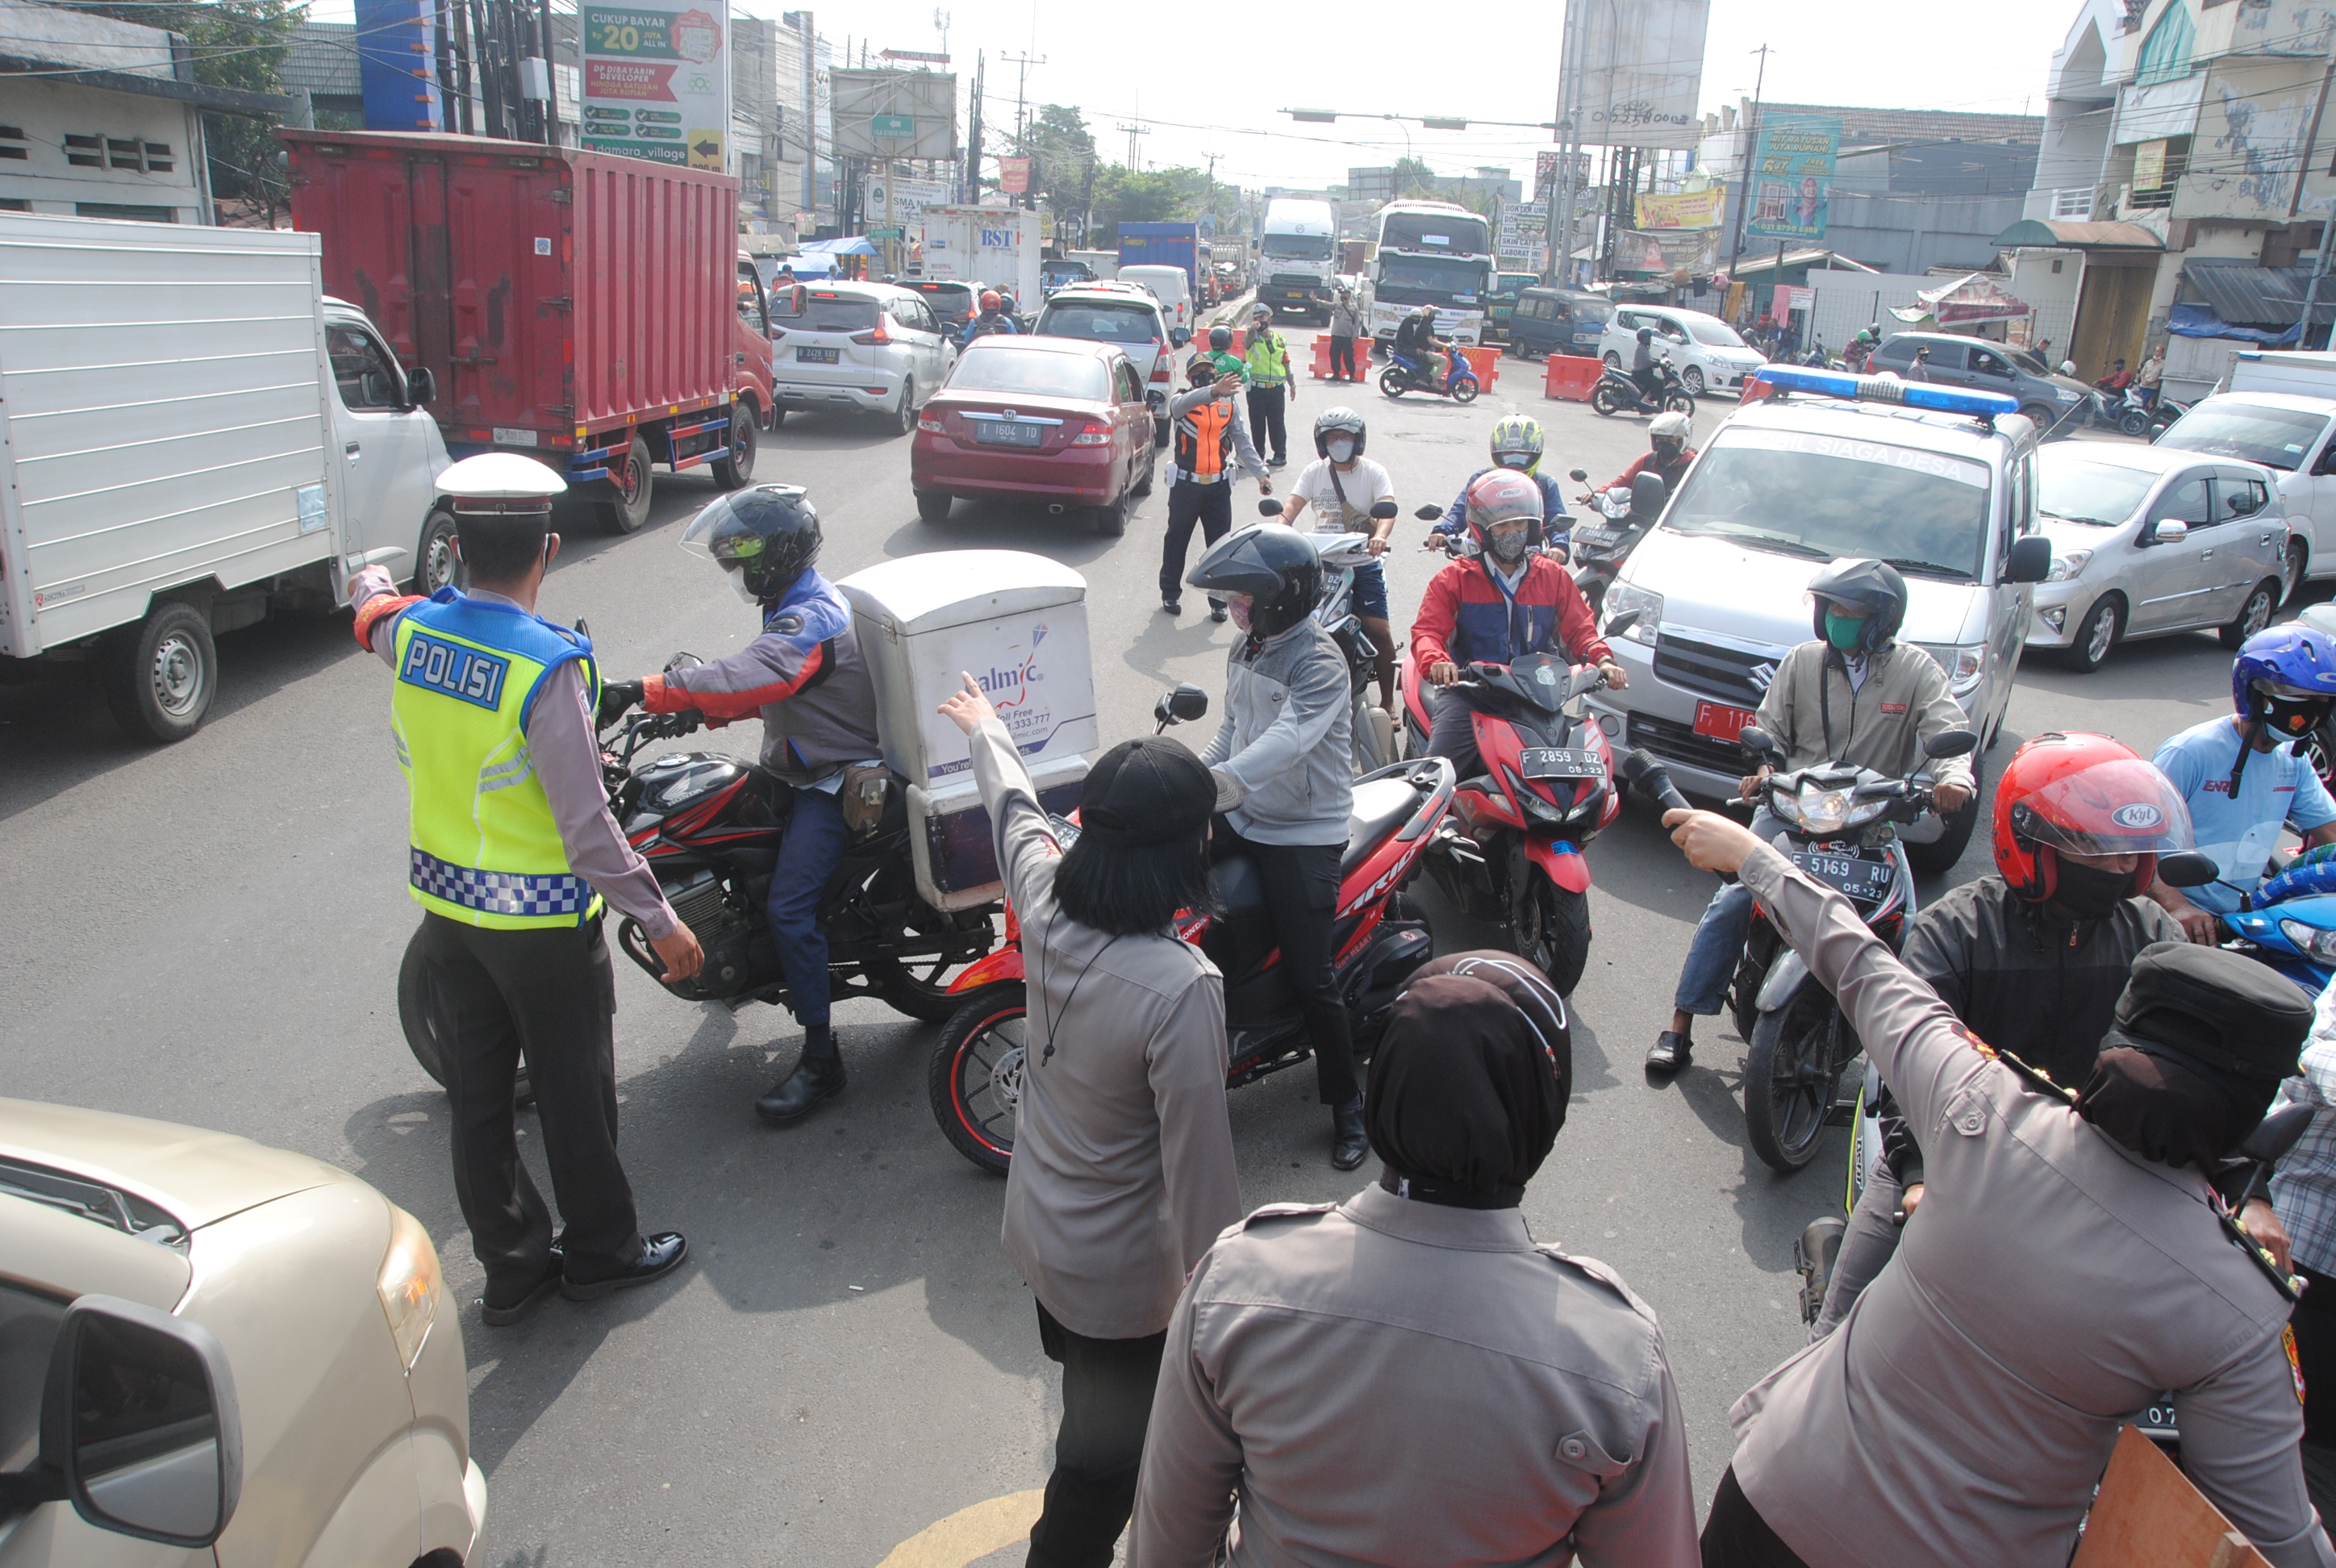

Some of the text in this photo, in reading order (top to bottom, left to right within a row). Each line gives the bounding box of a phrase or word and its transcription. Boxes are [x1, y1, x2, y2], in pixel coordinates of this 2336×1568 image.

[591, 14, 666, 28] CUKUP BAYAR
[592, 25, 639, 51] Rp 20
[900, 52, 939, 61] LOKASI
[600, 73, 649, 83] DEVELOPER
[607, 66, 656, 76] DIBAYARIN
[590, 81, 658, 90] HINGGA RATUSAN
[1767, 143, 1791, 151] JUTA
[1787, 136, 1831, 145] RATUSAN
[596, 144, 686, 161] damara_village
[1762, 160, 1775, 174] 6
[893, 197, 915, 207] SMA
[1505, 205, 1548, 215] DOKTER UMU
[982, 229, 1012, 247] BST
[807, 348, 822, 357] 2428
[982, 423, 1037, 438] T 1604 TD
[1816, 439, 1891, 463] SIAGA
[1896, 451, 1962, 480] DESA
[1328, 575, 1339, 584] DZ
[405, 639, 501, 703] POLISI
[1013, 709, 1033, 719] Free
[1700, 705, 1756, 730] F 116
[1011, 727, 1049, 741] almic.com
[1522, 751, 1600, 764] F 2859 DZ
[667, 788, 705, 807] HONDA
[1420, 796, 1443, 821] HONDA
[1811, 858, 1850, 877] 5169
[1871, 866, 1890, 883] RU
[1335, 848, 1416, 920] ARIO
[1349, 933, 1373, 957] HEART
